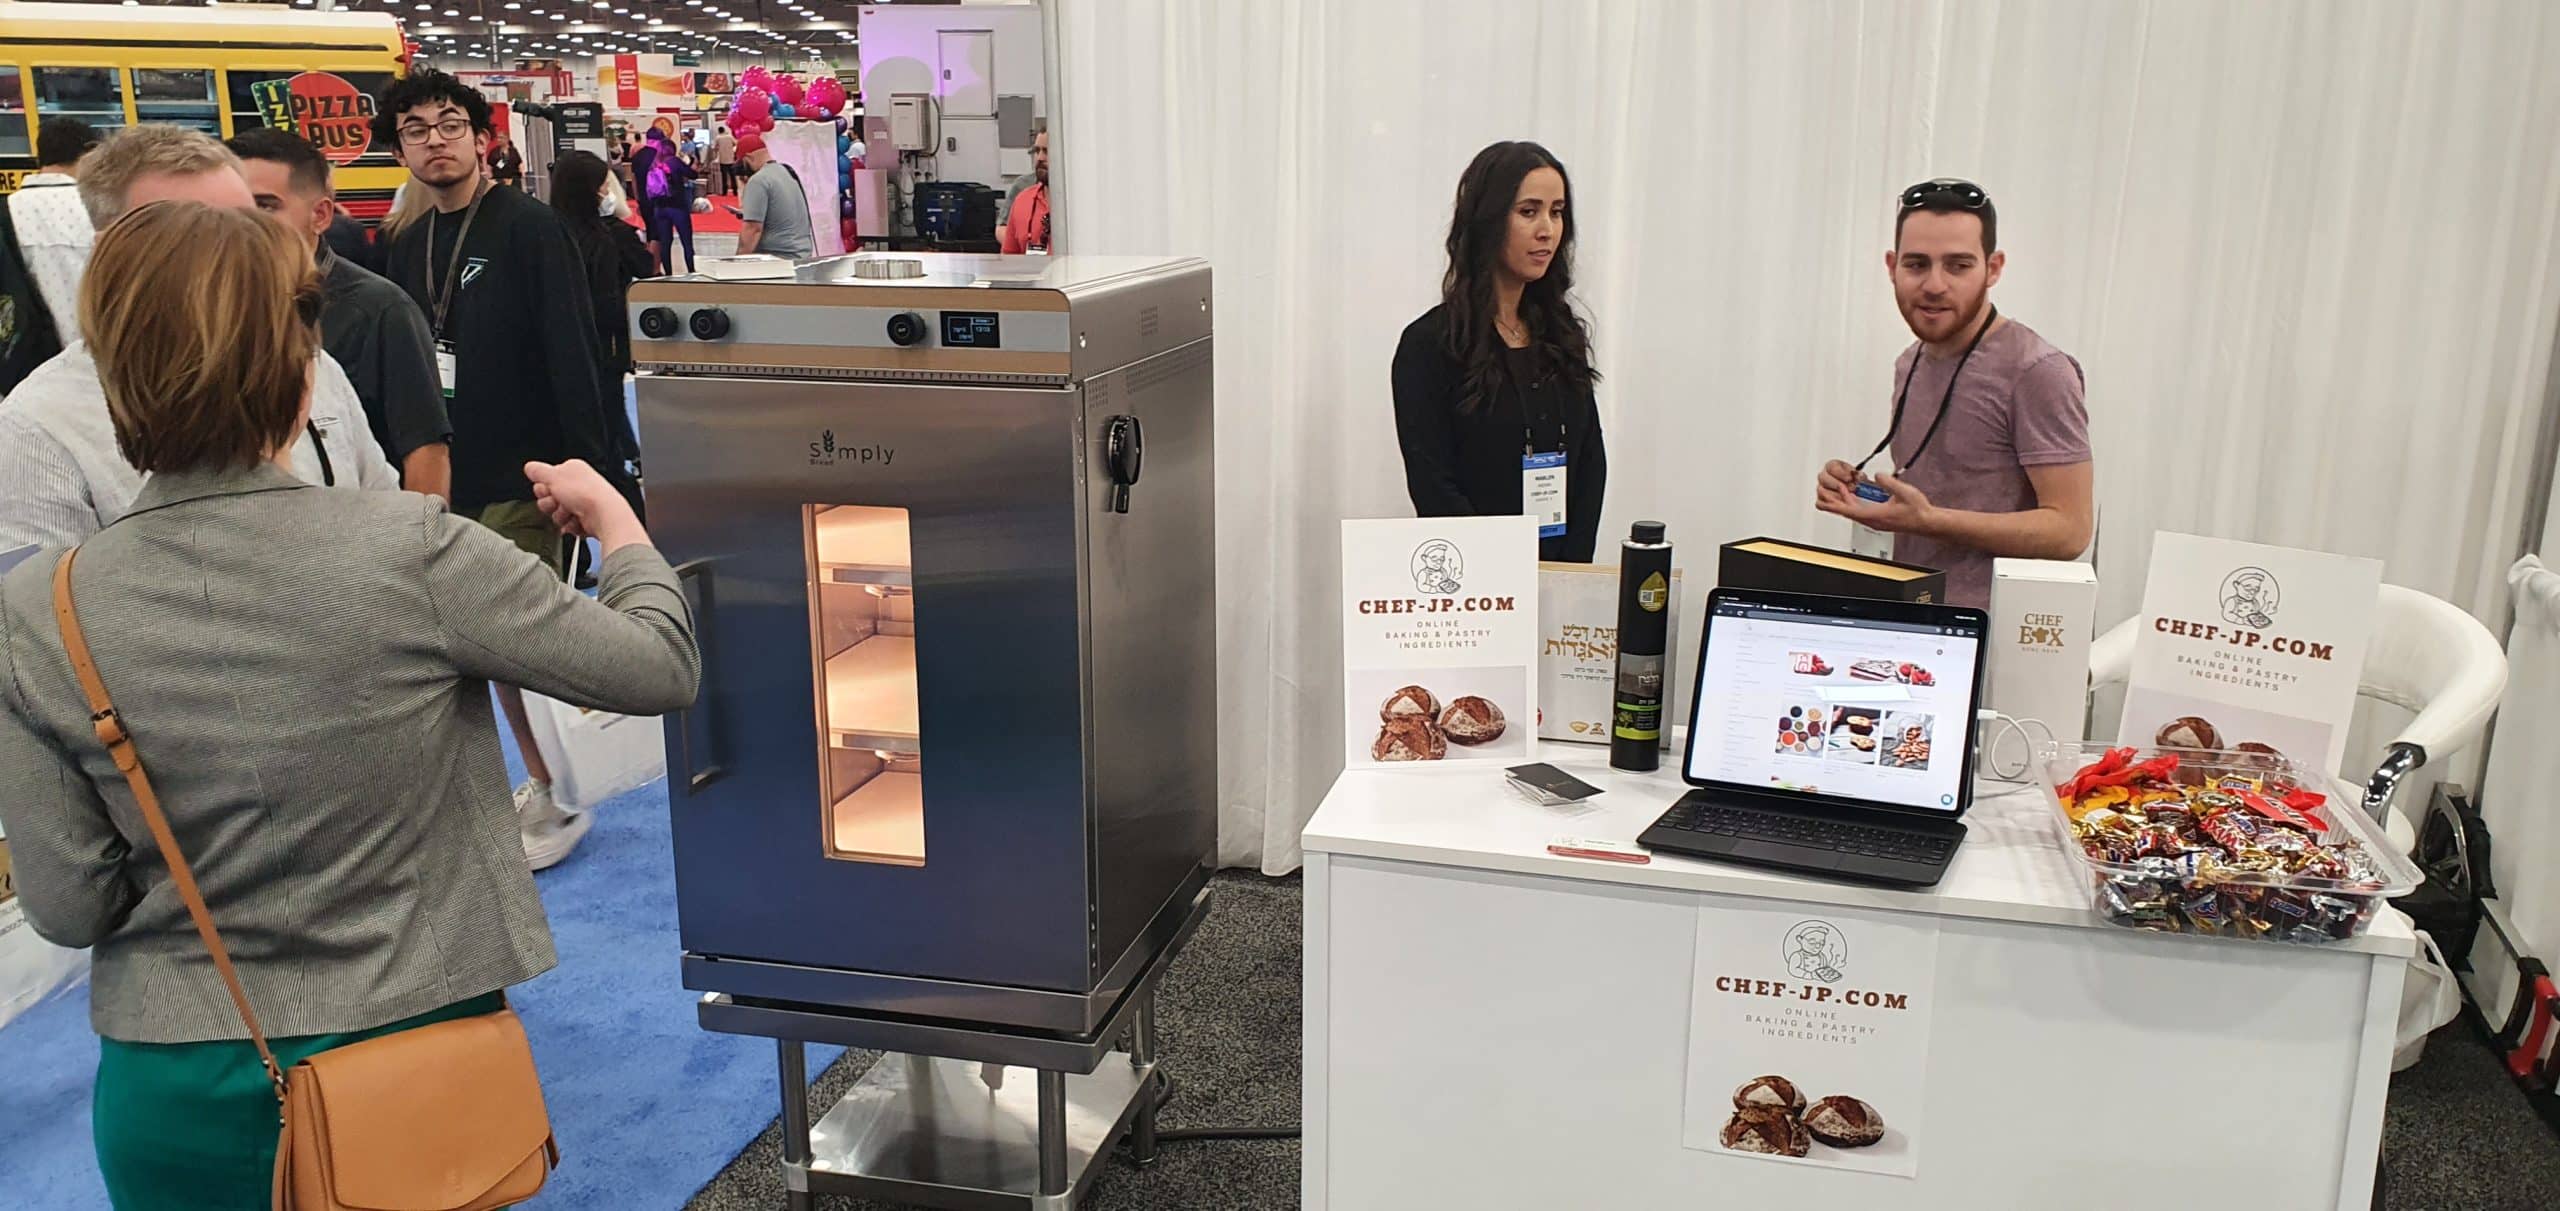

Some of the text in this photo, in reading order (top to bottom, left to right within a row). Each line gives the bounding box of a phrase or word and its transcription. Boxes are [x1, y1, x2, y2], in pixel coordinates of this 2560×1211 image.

[291, 94, 373, 120] PIZZA
[308, 122, 365, 149] BUS
[1359, 597, 1515, 614] CHEF-JP.COM
[1416, 620, 1460, 629] ONLINE
[2024, 613, 2064, 627] CHEF
[1385, 631, 1429, 640] BAKING
[1448, 630, 1492, 638] PASTRY
[2155, 617, 2334, 661] CHEF-JP.COM
[1400, 640, 1478, 649] INGREDIENTS
[2214, 651, 2263, 666] ONLINE
[2177, 655, 2299, 683] BAKING & PASTRY
[2190, 669, 2279, 691] INGREDIENTS
[1716, 975, 1909, 1010] CHEF-JP.COM
[1784, 1007, 1838, 1020] ONLINE
[1745, 1014, 1877, 1035] BAKING & PASTRY
[1761, 1028, 1859, 1045] INGREDIENTS
